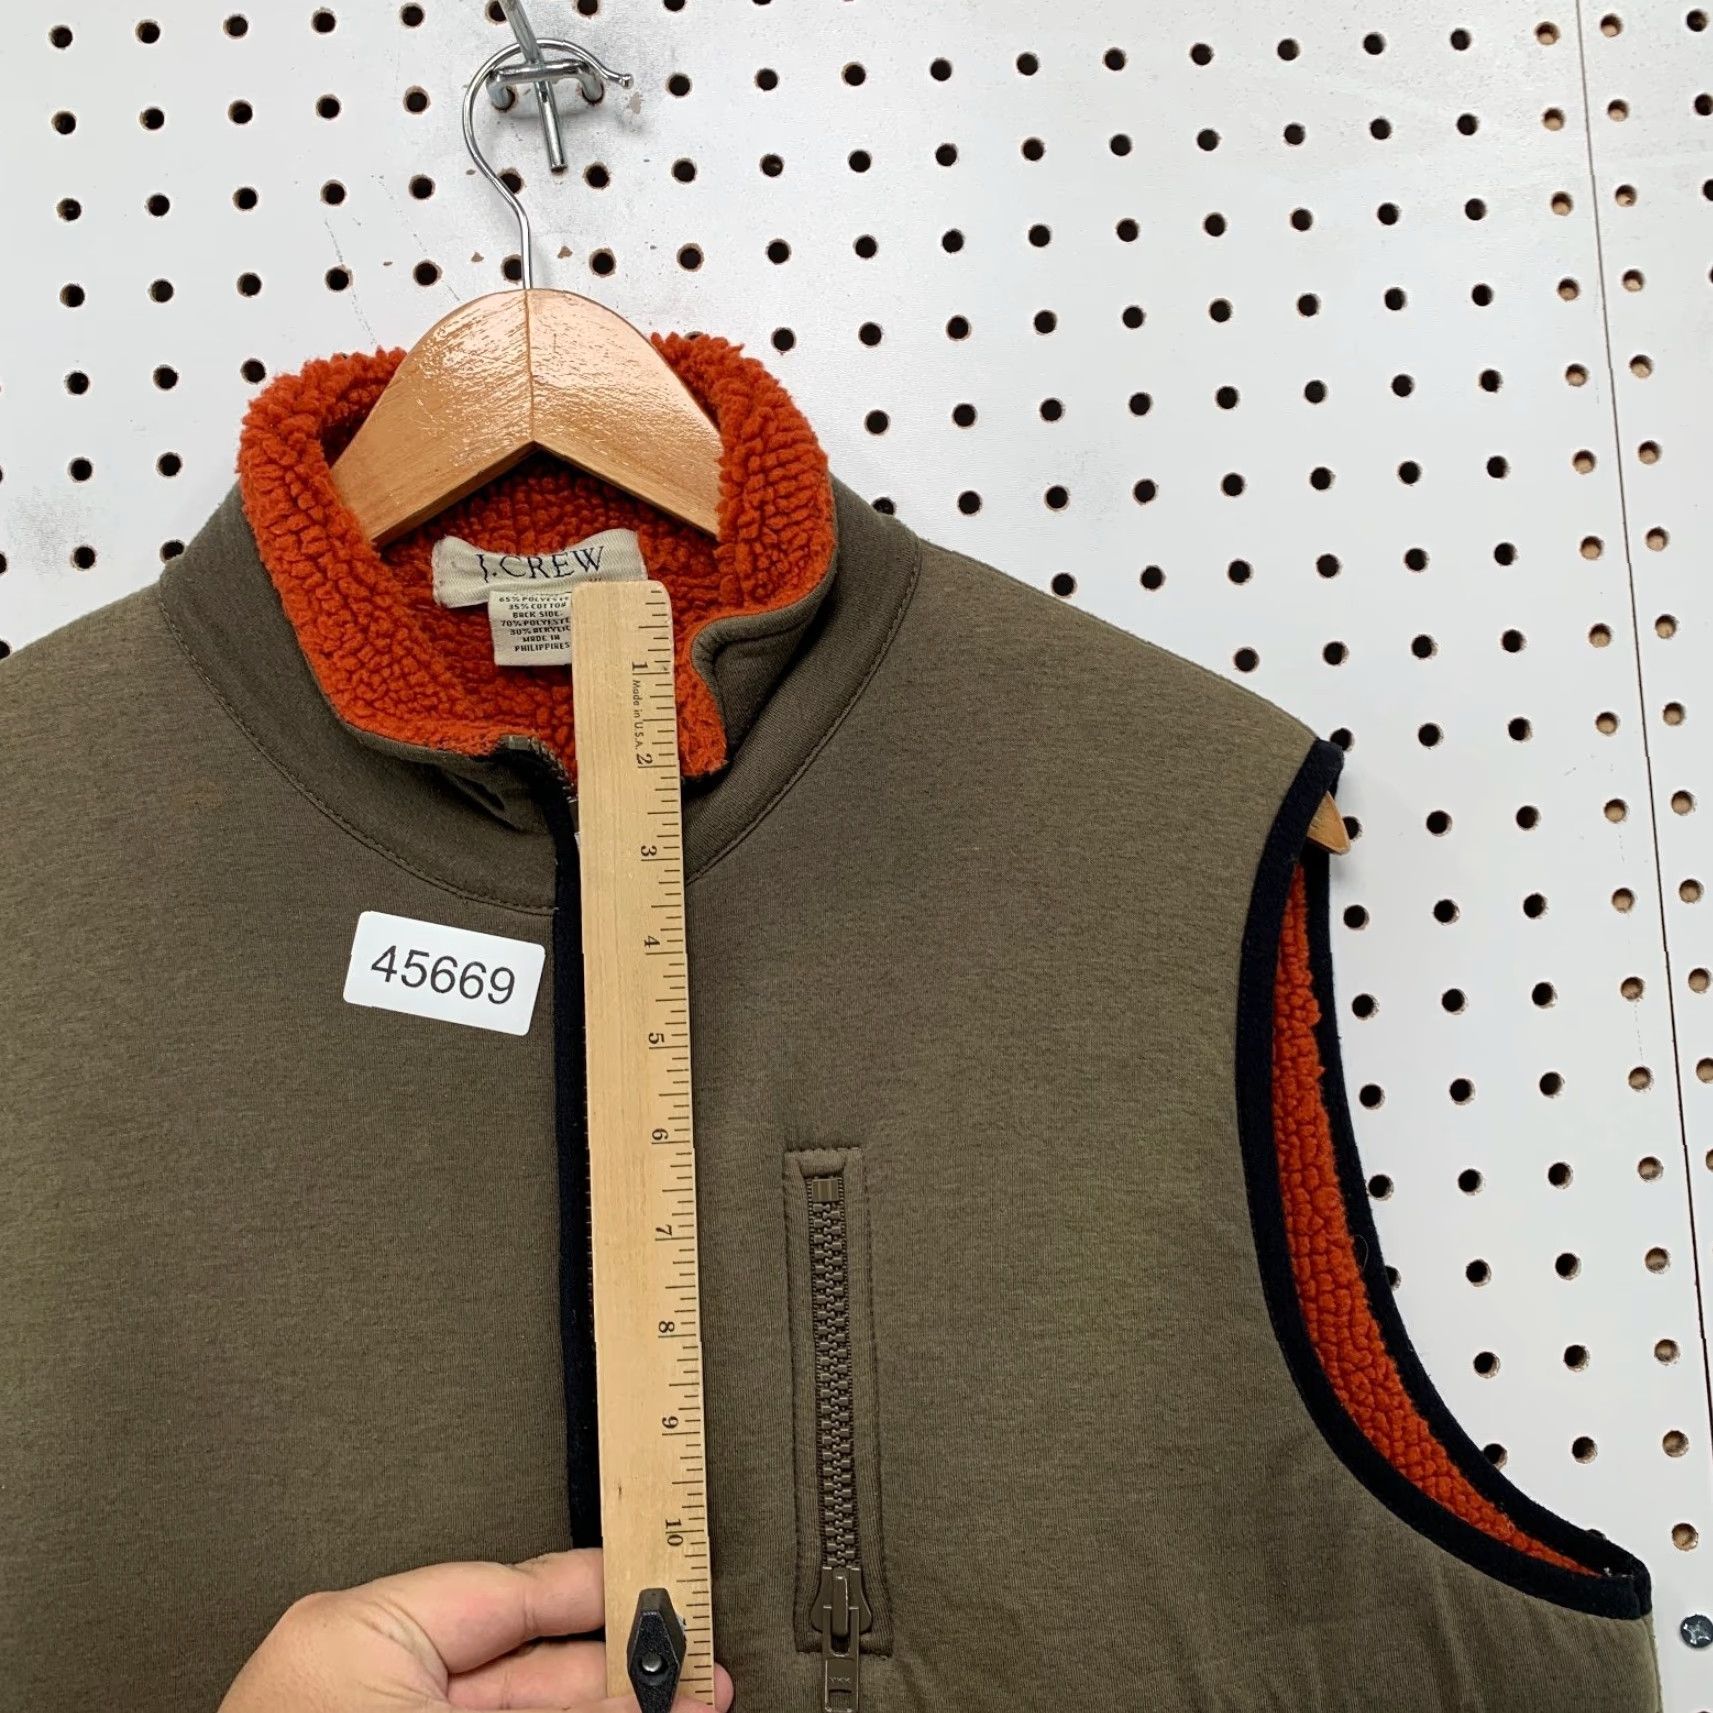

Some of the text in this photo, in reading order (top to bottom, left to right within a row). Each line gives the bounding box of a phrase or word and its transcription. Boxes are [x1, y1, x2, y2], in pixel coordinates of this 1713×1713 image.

[475, 545, 605, 584] J.CREW
[522, 635, 548, 643] MADE
[514, 641, 570, 652] PHILIPPINES
[631, 661, 648, 671] 1
[632, 679, 643, 706] Made
[633, 709, 643, 718] in
[636, 752, 653, 765] 2
[640, 844, 658, 857] 3
[643, 935, 661, 949] 4
[370, 944, 516, 1005] 45669
[648, 1032, 665, 1045] 5
[651, 1127, 669, 1141] 6
[655, 1223, 673, 1236] 7
[658, 1320, 676, 1333] 8
[661, 1415, 679, 1429] 9
[665, 1518, 684, 1547] 10
